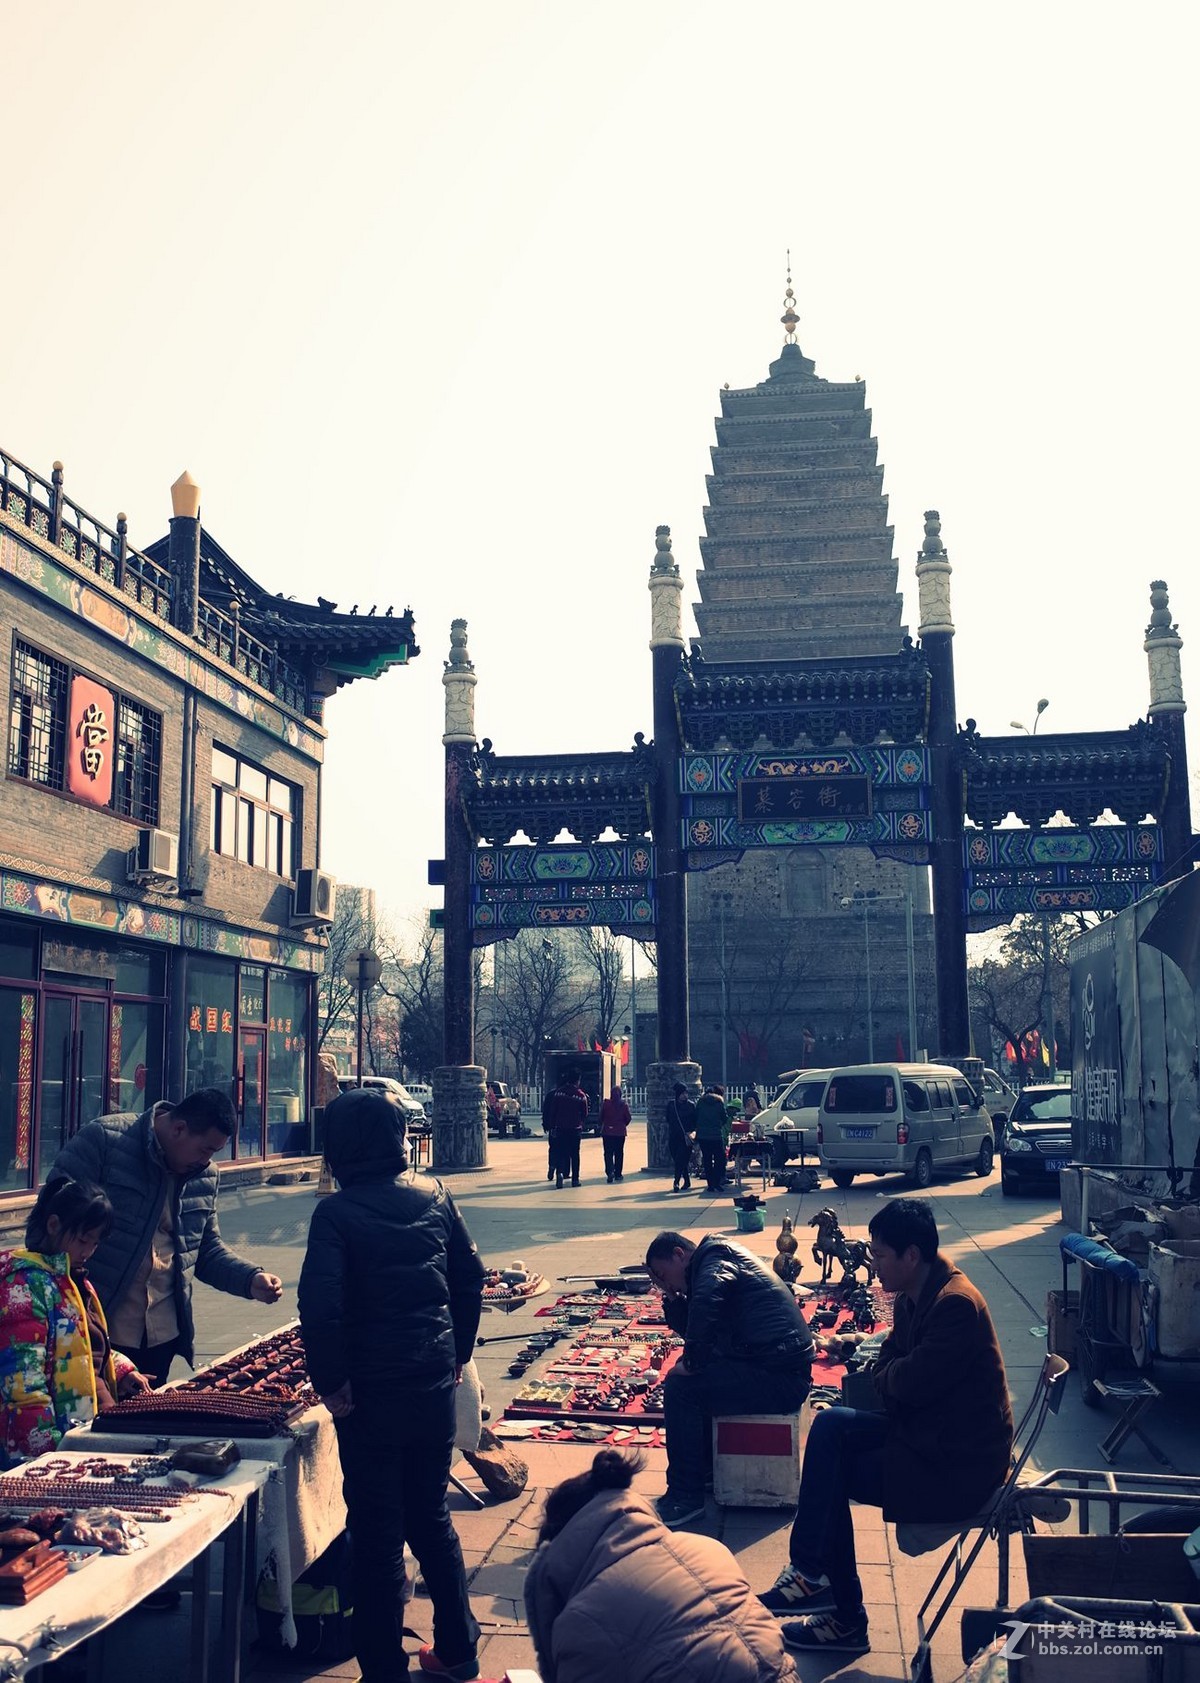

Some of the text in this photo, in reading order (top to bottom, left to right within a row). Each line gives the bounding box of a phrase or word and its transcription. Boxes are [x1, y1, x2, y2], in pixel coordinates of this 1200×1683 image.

[754, 783, 842, 814] 慕容街
[190, 1005, 232, 1033] 战国红
